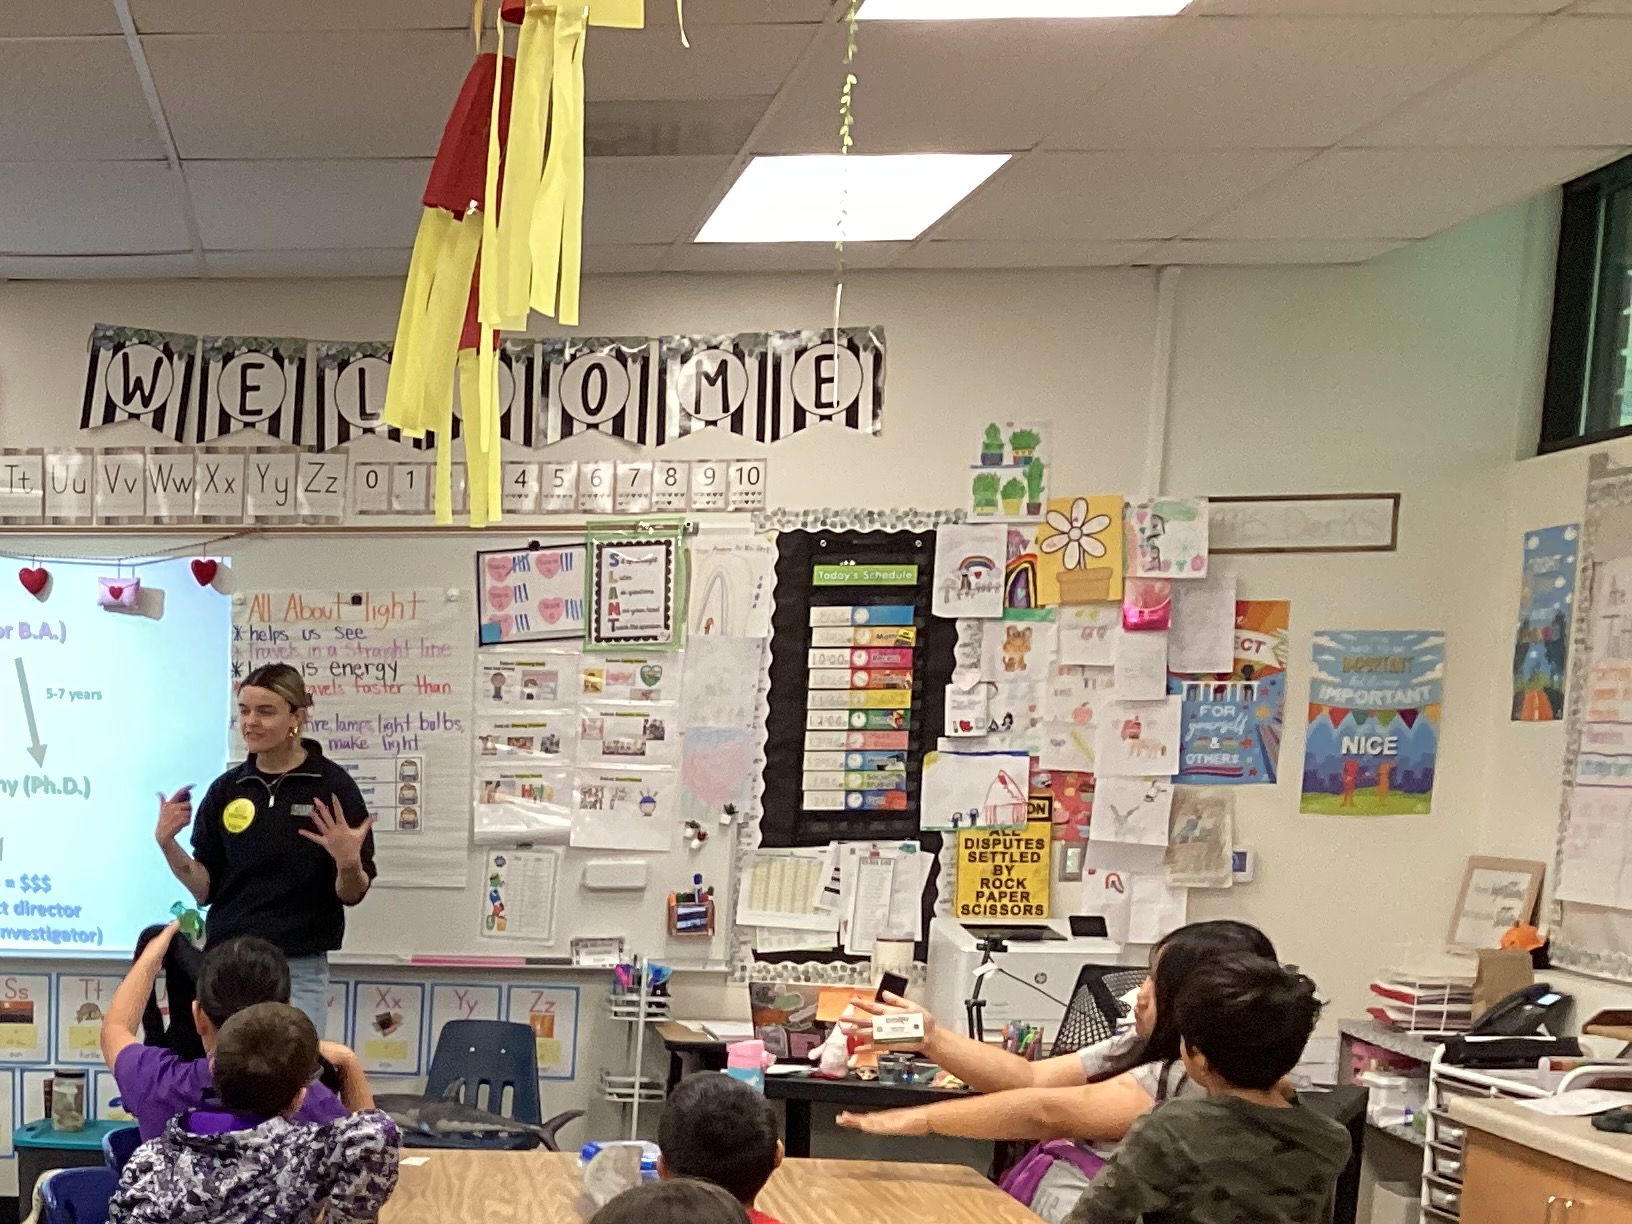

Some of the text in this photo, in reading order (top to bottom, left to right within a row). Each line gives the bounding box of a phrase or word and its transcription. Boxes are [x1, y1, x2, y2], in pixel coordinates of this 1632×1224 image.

[104, 464, 138, 494] Vv
[148, 463, 193, 494] Ww
[205, 463, 235, 494] Xx
[257, 463, 289, 506] Yy
[304, 462, 338, 494] Zz
[366, 466, 760, 489] 0 1 4 5 6 7 8 9 10
[818, 569, 913, 582] Today's Schedule
[247, 592, 426, 630] All About light
[18, 620, 67, 644] B.A.)
[249, 626, 321, 649] helps us
[329, 660, 398, 682] energy
[415, 674, 452, 695] than
[46, 688, 103, 702] 5-7 years
[1319, 684, 1432, 706] IMPORTANT
[1199, 705, 1236, 717] FOR
[378, 712, 411, 737] light
[328, 733, 419, 755] make light
[1340, 736, 1399, 756] NICE
[1185, 753, 1240, 765] OTHERS
[23, 774, 91, 800] (Ph.D.)
[964, 838, 1045, 850] DISPUTES
[967, 851, 1041, 864] SETTLED
[992, 864, 1014, 876] BY
[19, 873, 52, 893] $$$
[980, 877, 1027, 890] ROCK
[975, 890, 1031, 903] PAPER
[13, 899, 82, 918] director
[960, 904, 1044, 917] SCISSORS
[4, 978, 29, 1000] Ss
[79, 978, 104, 1000] Tt
[375, 986, 402, 1009] Xx
[454, 989, 478, 1020] Yy
[529, 990, 557, 1013] Zz
